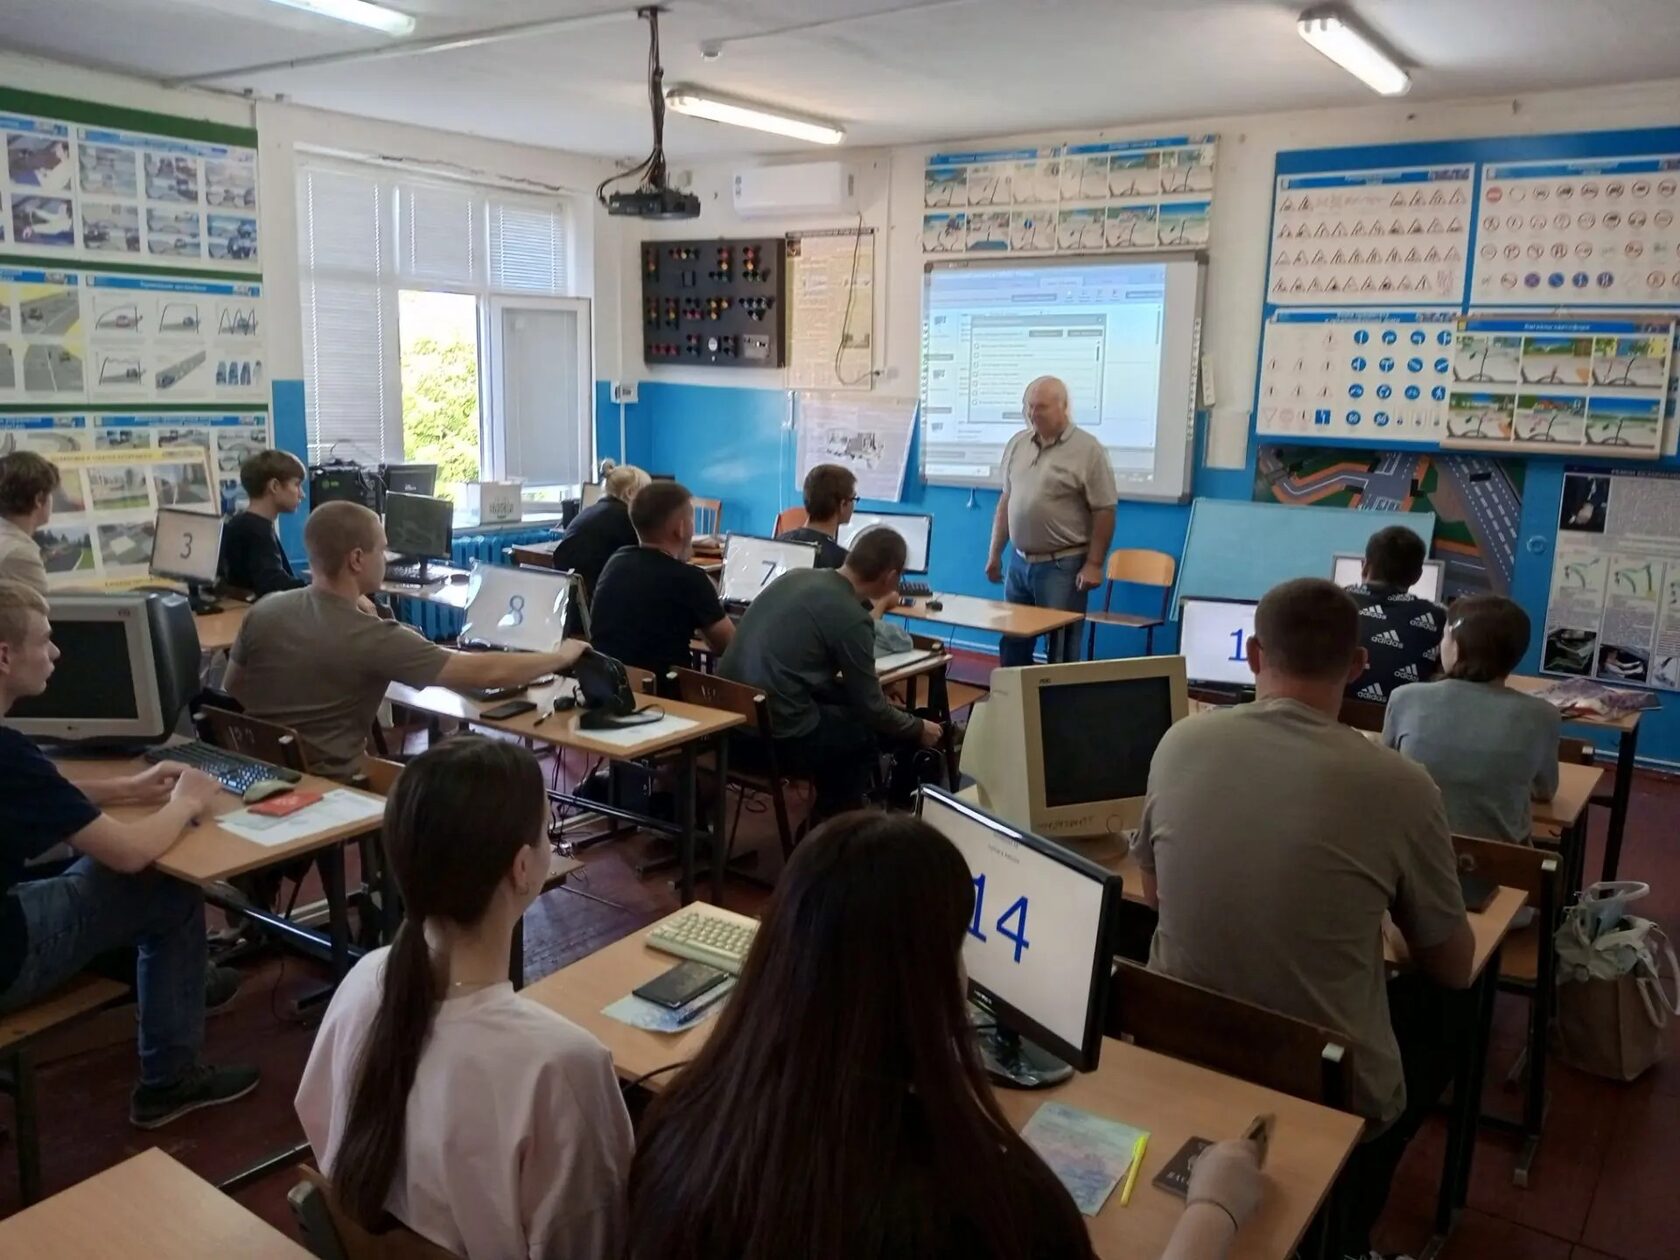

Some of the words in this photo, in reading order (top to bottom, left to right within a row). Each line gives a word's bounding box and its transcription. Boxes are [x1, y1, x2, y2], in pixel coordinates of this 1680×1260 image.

[180, 532, 193, 560] 3
[760, 560, 777, 587] 7
[508, 594, 525, 628] 8
[1359, 608, 1387, 620] adidas
[1409, 619, 1437, 632] adidas
[1371, 635, 1404, 649] adidas
[1357, 690, 1388, 703] adidas
[967, 872, 1030, 964] 14
